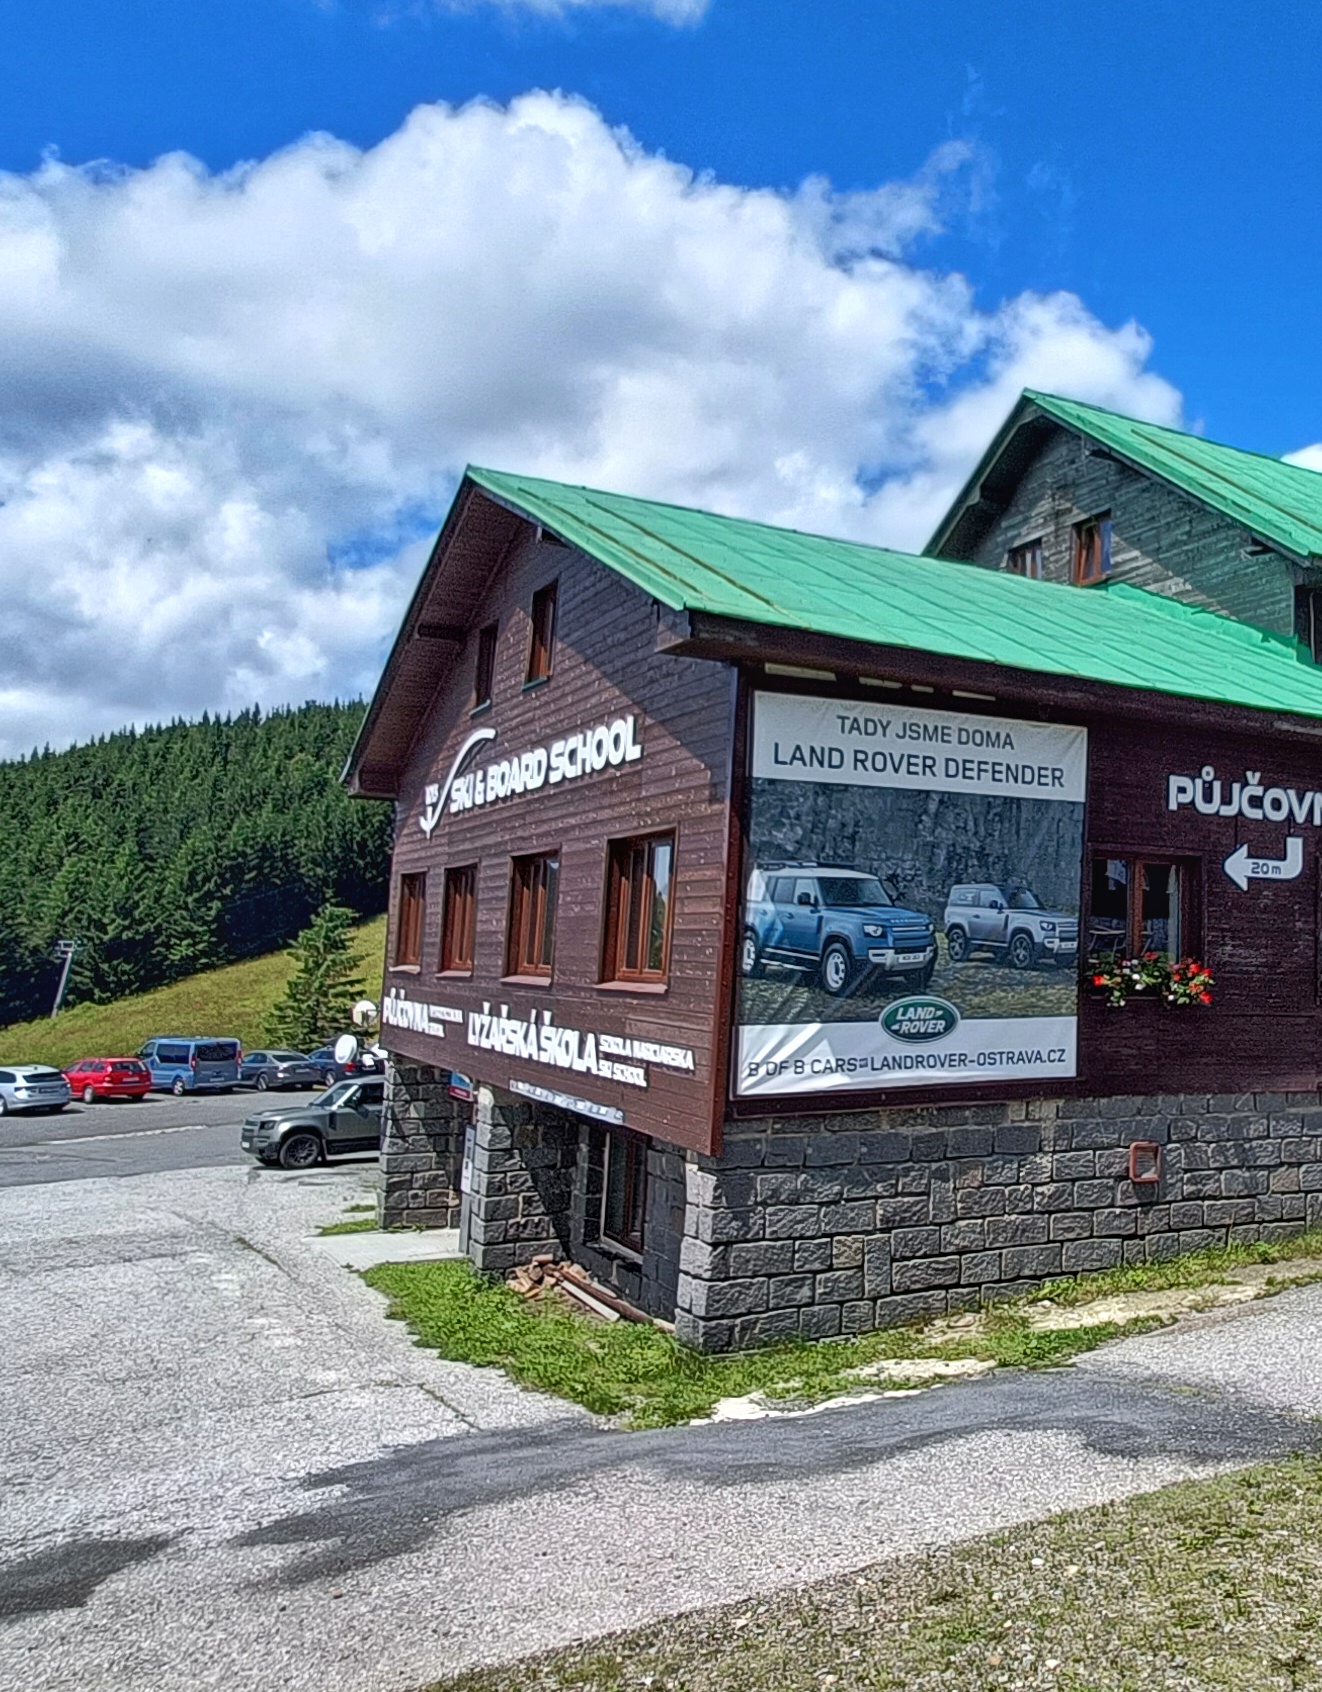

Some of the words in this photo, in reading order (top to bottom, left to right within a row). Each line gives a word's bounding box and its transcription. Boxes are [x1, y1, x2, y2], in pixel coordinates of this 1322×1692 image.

[837, 714, 891, 738] TADY
[895, 720, 952, 744] JSME
[957, 727, 1015, 751] DOMA
[450, 773, 474, 813] SKI
[486, 748, 547, 802] BOARD
[549, 715, 642, 784] SCHOOL
[773, 742, 845, 770] LAND
[853, 749, 937, 777] ROVER
[944, 757, 1065, 788] DEFENDER
[896, 1007, 936, 1020] LAND
[899, 1020, 946, 1034] ROVER
[467, 1001, 539, 1061] LYŽAŘSKÁ
[539, 1010, 600, 1075] ŠKOLA
[810, 1057, 858, 1074] CARS
[870, 1048, 1066, 1071] LANDROVER-OSTRAVA.CZ
